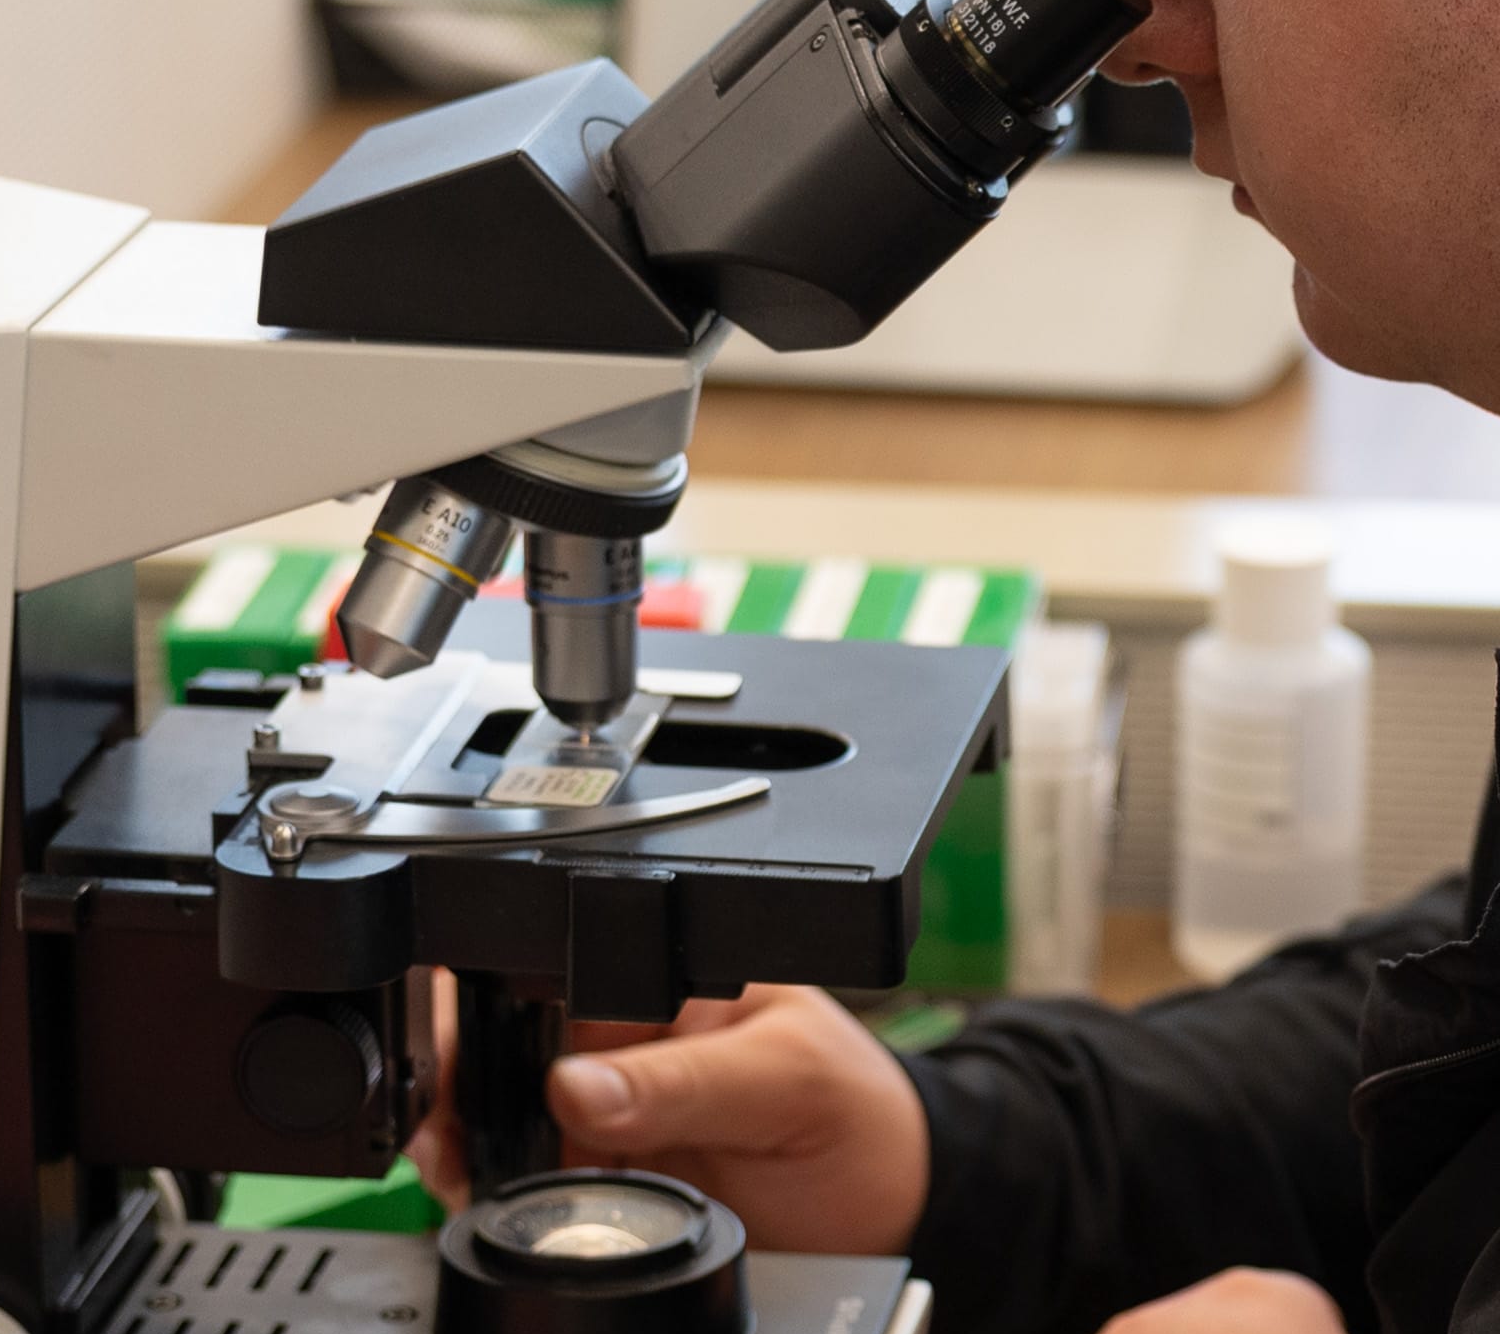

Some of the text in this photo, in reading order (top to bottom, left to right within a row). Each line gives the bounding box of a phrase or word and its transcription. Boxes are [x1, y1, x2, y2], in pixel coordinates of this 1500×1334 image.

[958, 2, 997, 55] 3121118
[987, 11, 1007, 38] 18)
[420, 497, 473, 535] E A10
